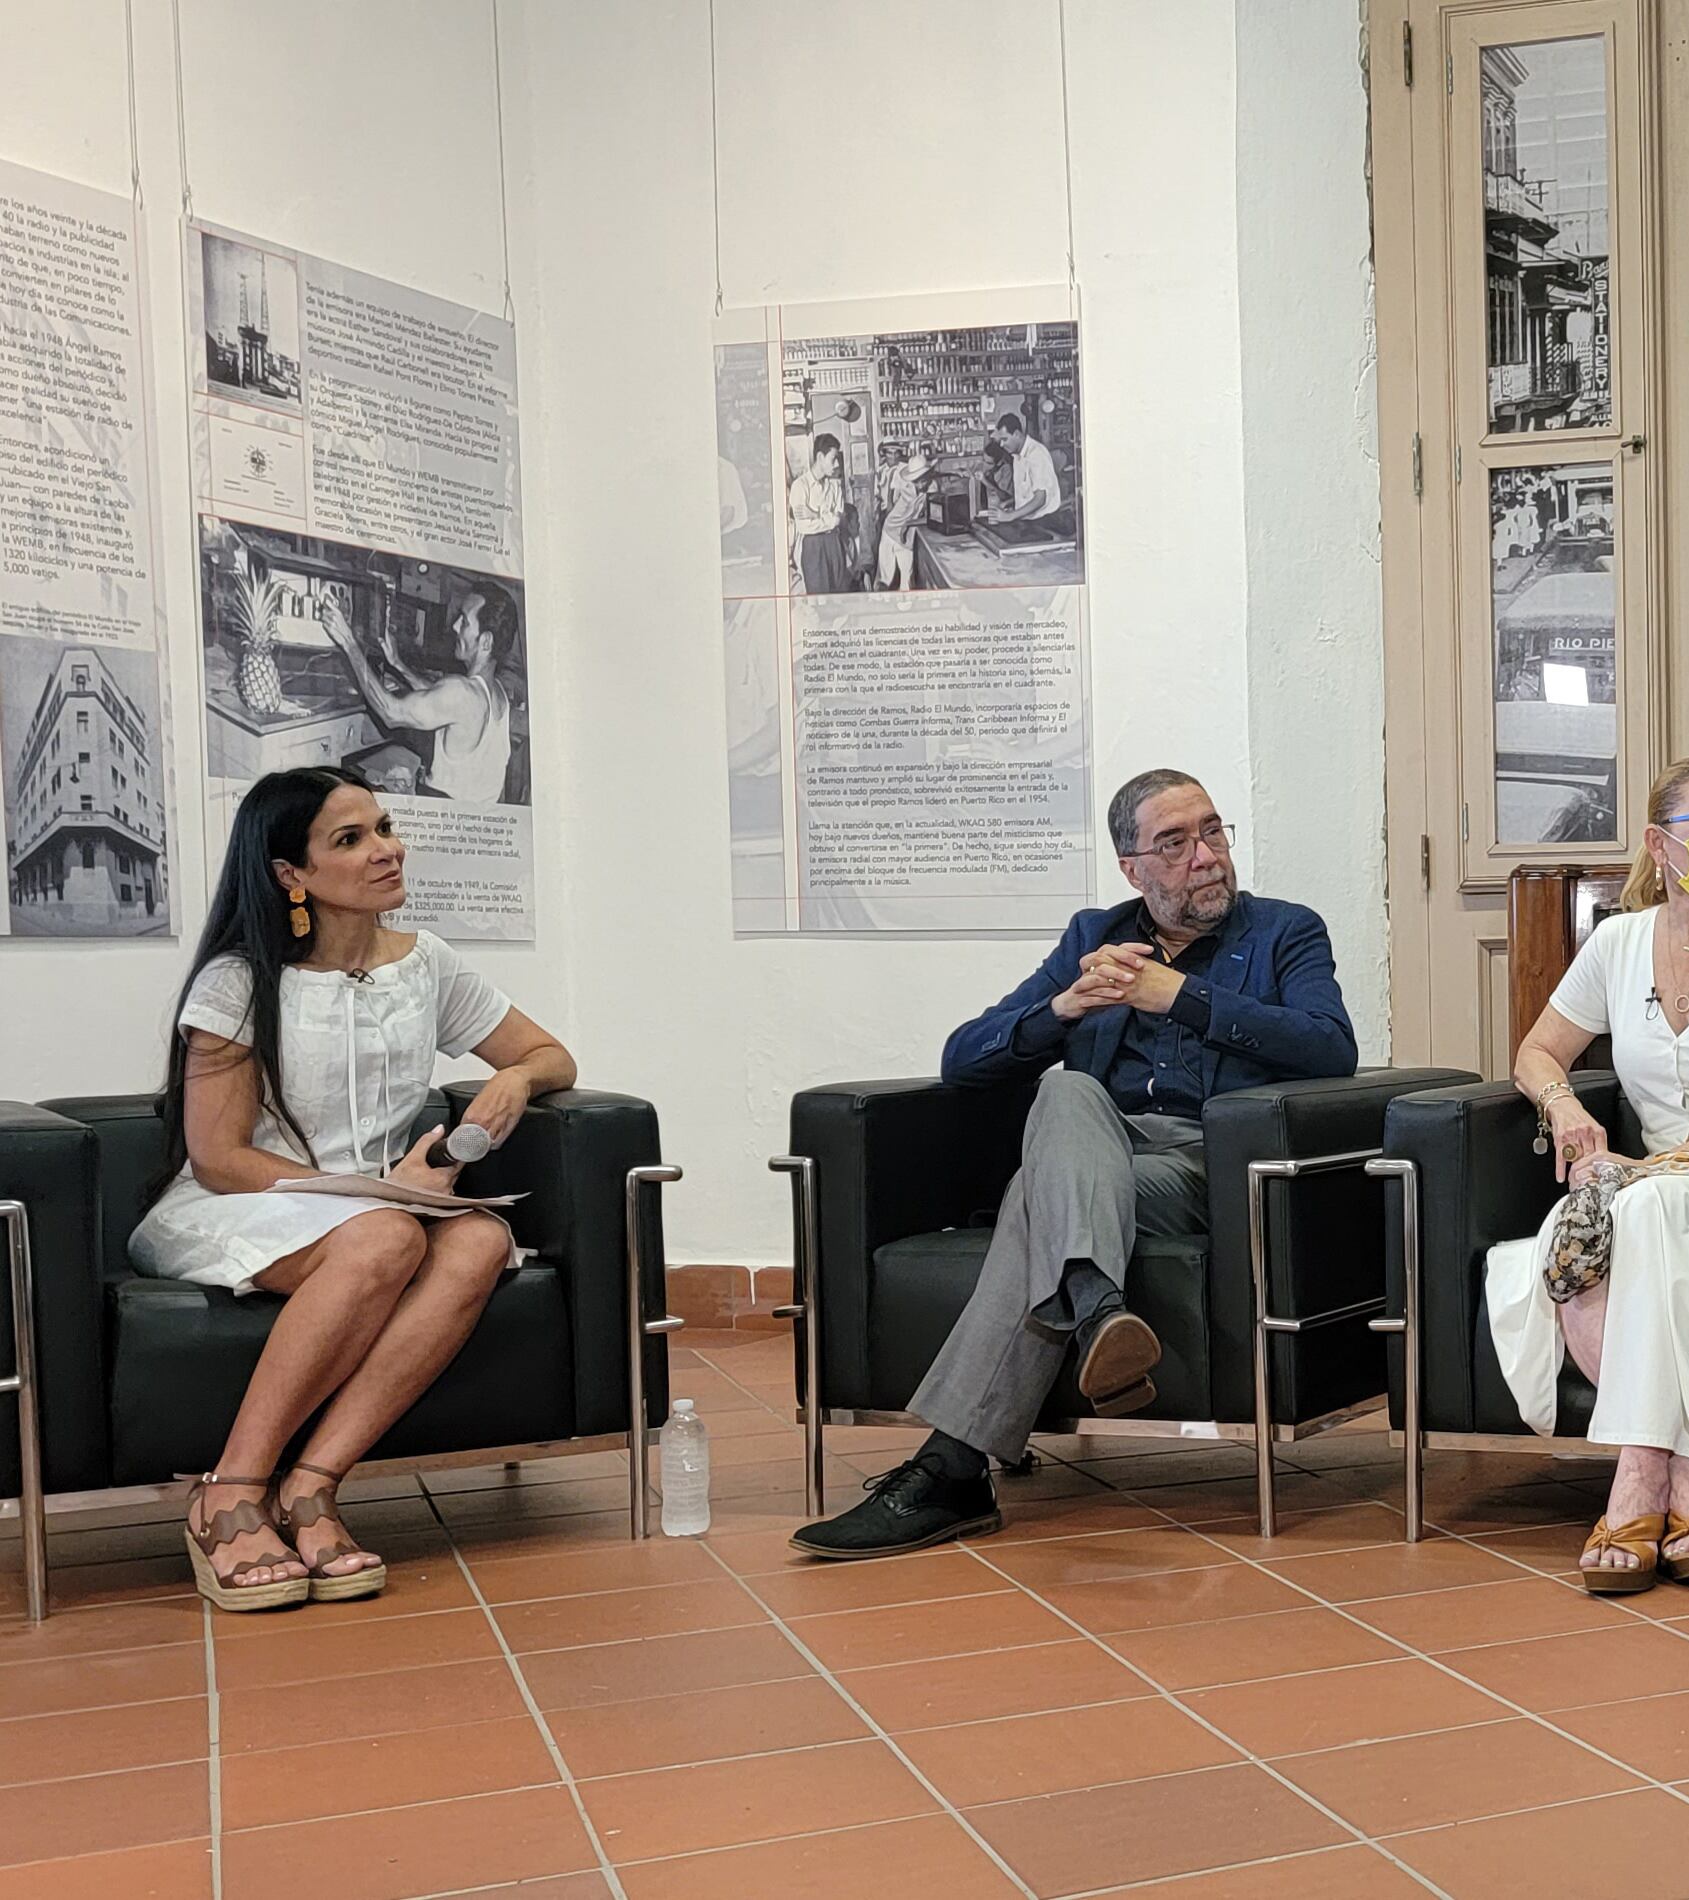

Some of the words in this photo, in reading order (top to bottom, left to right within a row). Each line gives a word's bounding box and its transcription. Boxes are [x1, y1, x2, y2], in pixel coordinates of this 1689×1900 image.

[28, 231, 59, 249] terreno
[62, 243, 86, 256] como
[89, 250, 119, 266] nuevos
[68, 272, 89, 284] poco
[64, 283, 91, 299] pilares
[9, 281, 25, 298] hoy
[56, 296, 88, 311] conoce
[91, 305, 114, 318] como
[1594, 279, 1608, 389] STATIONERY
[71, 475, 93, 491] Viejo
[33, 484, 49, 494] con
[52, 488, 86, 501] paredes
[22, 496, 52, 511] equipo
[1, 506, 36, 520] mejores
[40, 513, 77, 527] emisoras
[81, 520, 122, 534] existentes
[3, 547, 25, 560] 1320
[78, 561, 93, 570] una
[96, 563, 132, 576] potencia
[3, 561, 29, 574] 5,000
[945, 622, 980, 631] habilidad
[1554, 637, 1583, 649] RIO
[1589, 638, 1615, 649] PIE
[804, 685, 832, 696] primera
[860, 685, 873, 694] que
[893, 717, 918, 725] Guerra
[955, 715, 974, 723] Trans
[977, 714, 1017, 723] Caribbean
[845, 800, 859, 808] que
[871, 797, 895, 808] propio
[961, 795, 985, 804] Puerto
[988, 795, 1004, 803] Rico
